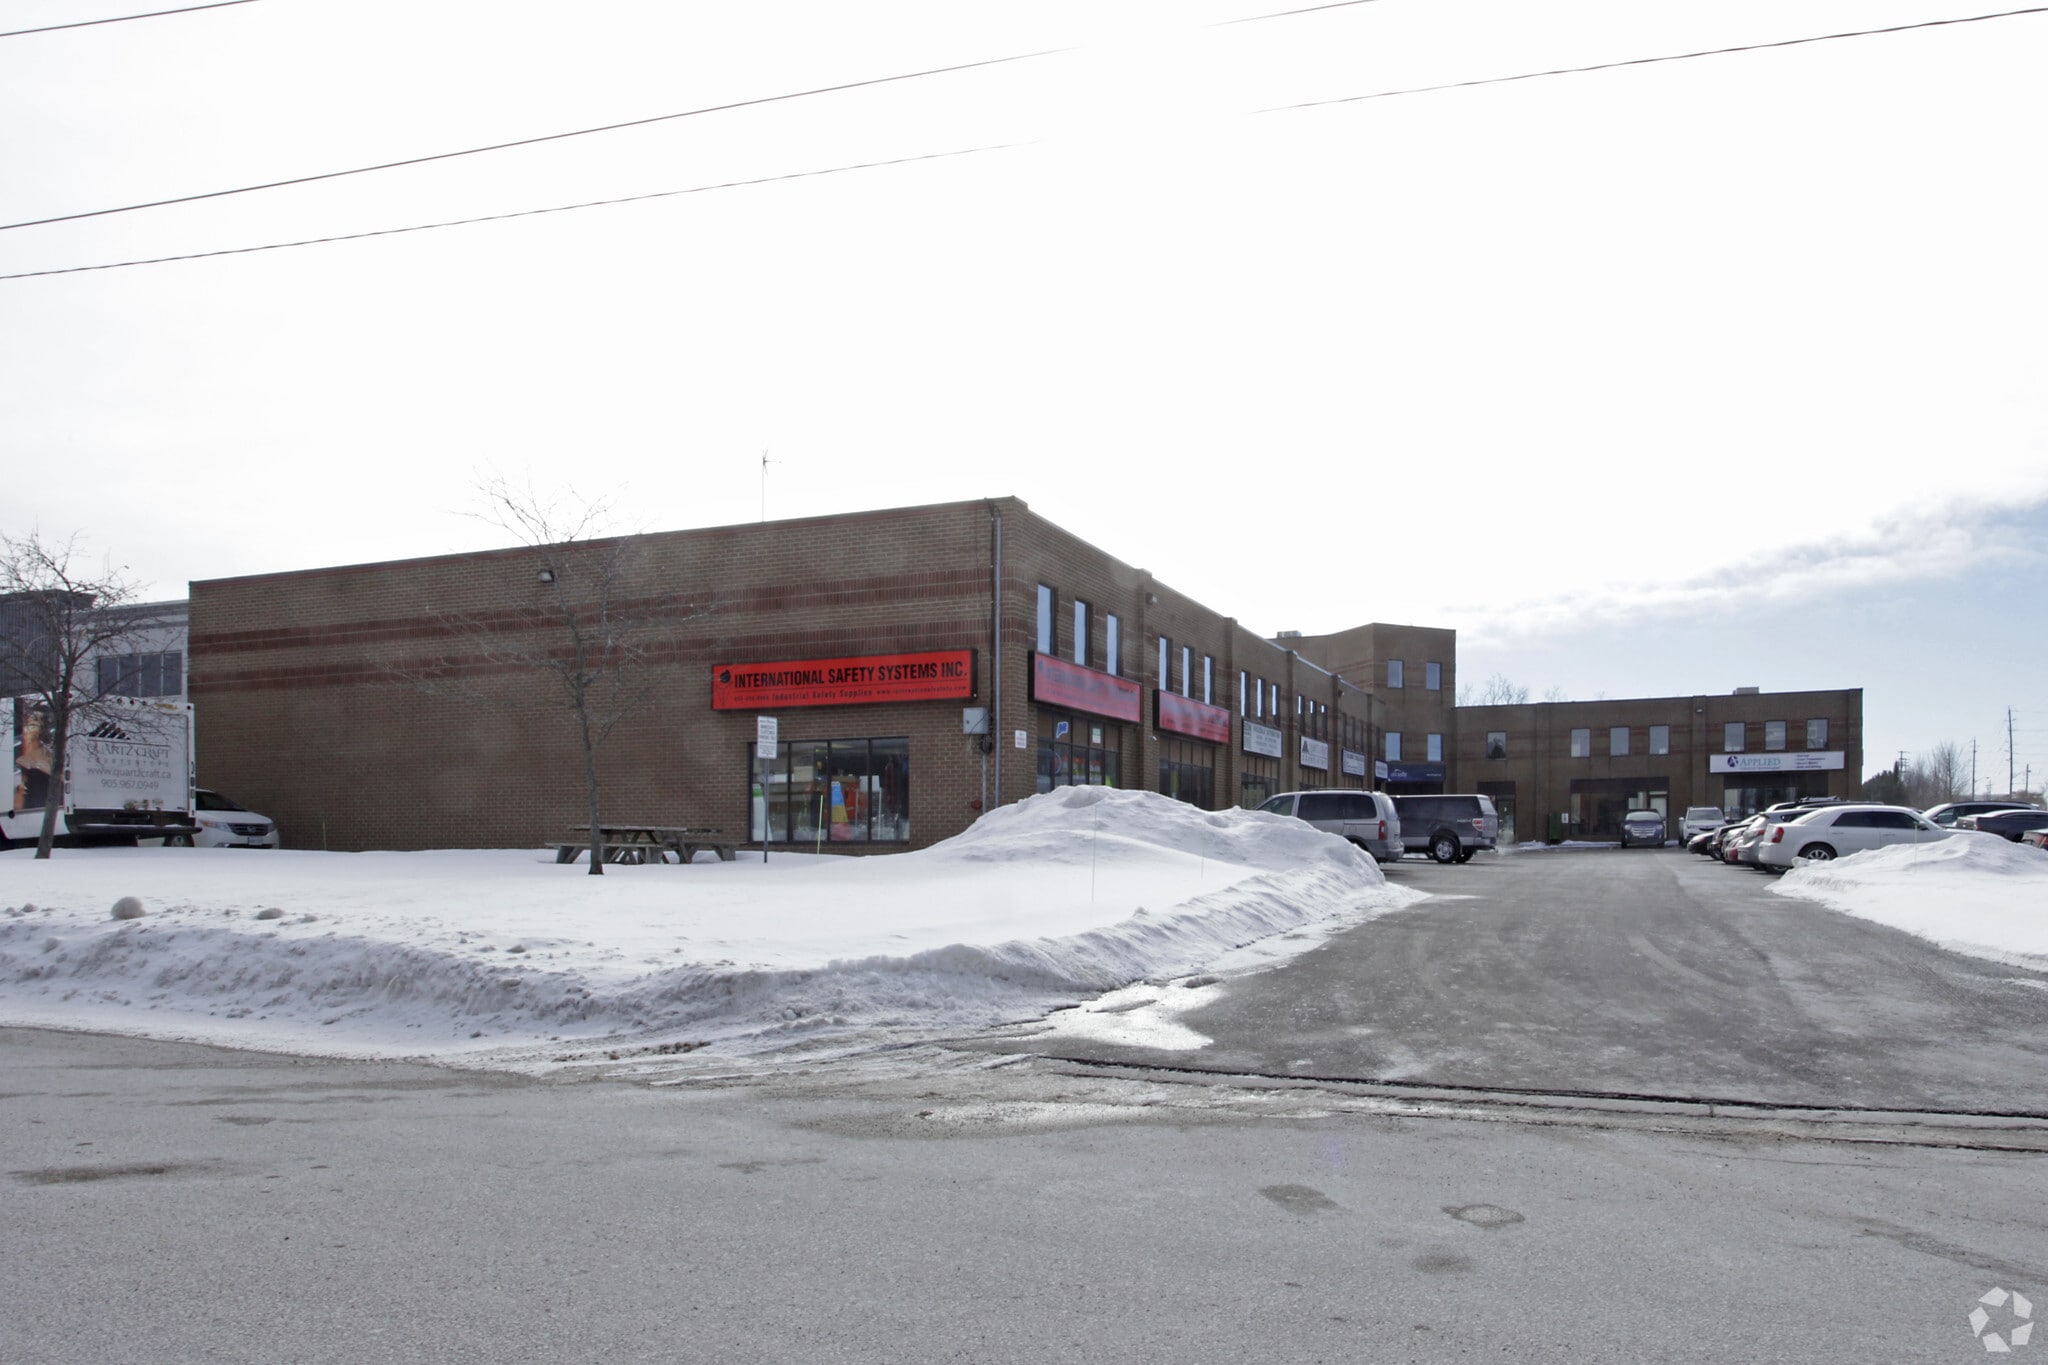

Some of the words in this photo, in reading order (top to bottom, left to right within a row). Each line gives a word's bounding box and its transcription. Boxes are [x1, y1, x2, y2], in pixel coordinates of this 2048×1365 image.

[734, 670, 824, 688] INTERNATIONAL
[829, 666, 874, 685] SAFETY
[878, 663, 938, 681] SYSTEMS
[941, 661, 968, 678] INC.
[771, 690, 809, 702] Industrial
[812, 689, 837, 700] Safety
[839, 687, 873, 699] Supplies
[1741, 757, 1781, 766] APPLIED
